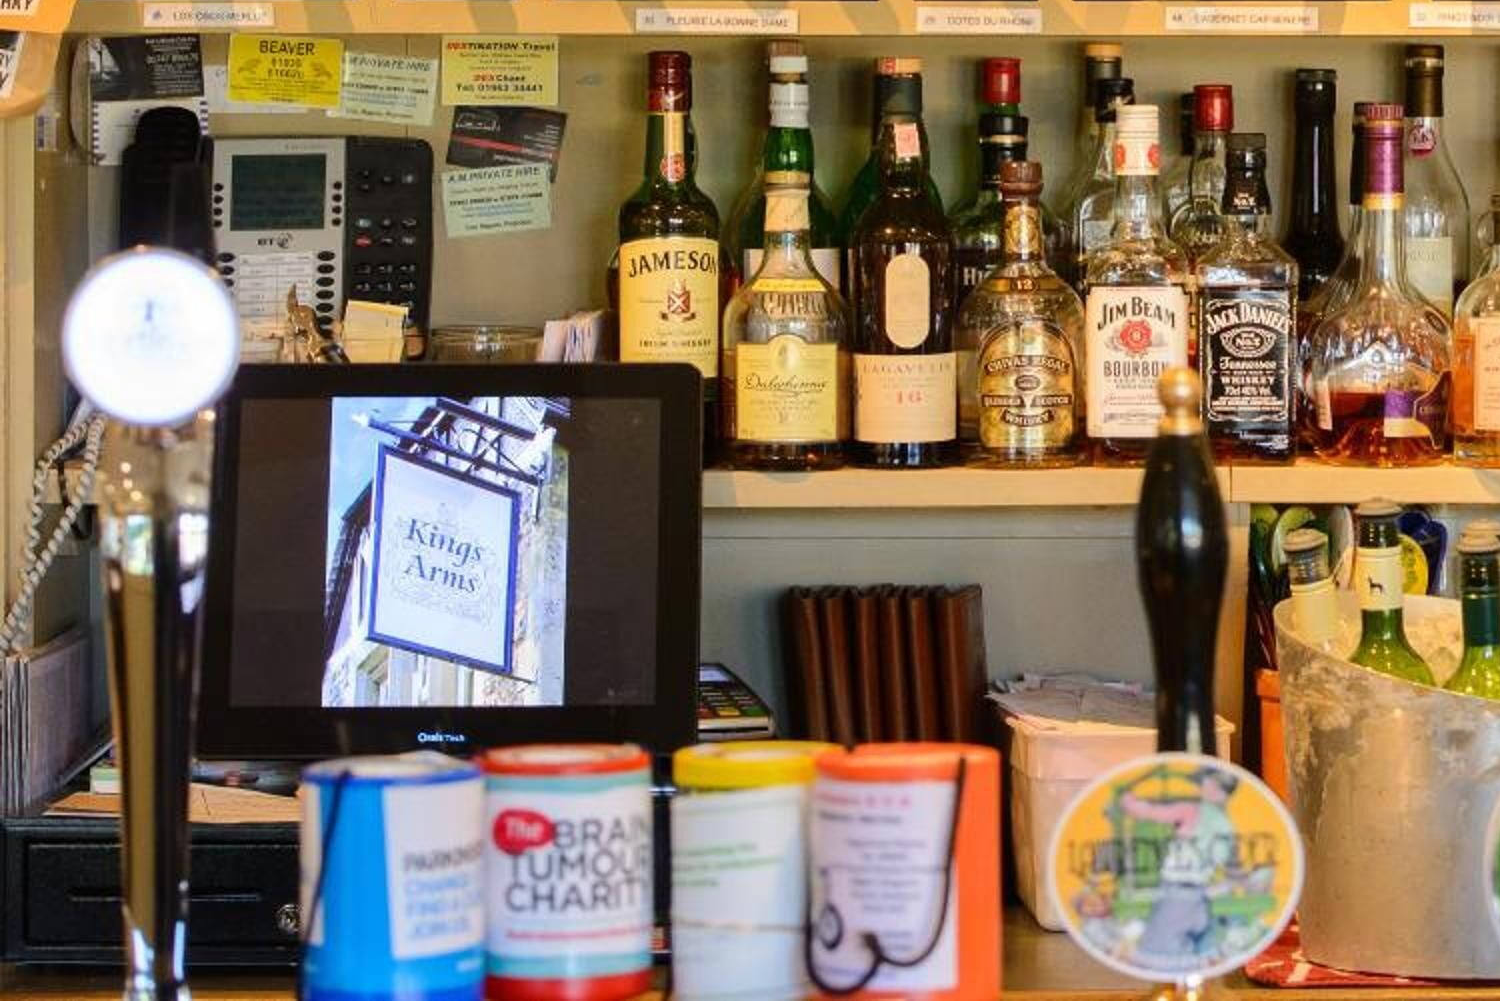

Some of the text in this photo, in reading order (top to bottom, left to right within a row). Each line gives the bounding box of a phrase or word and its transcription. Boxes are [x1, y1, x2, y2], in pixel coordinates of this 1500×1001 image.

[259, 40, 315, 56] BEAVER
[1015, 280, 1032, 290] 12
[1097, 296, 1175, 330] JIM BEAM
[1206, 306, 1238, 335] JACK
[406, 517, 483, 568] Kings
[404, 554, 480, 594] Arms
